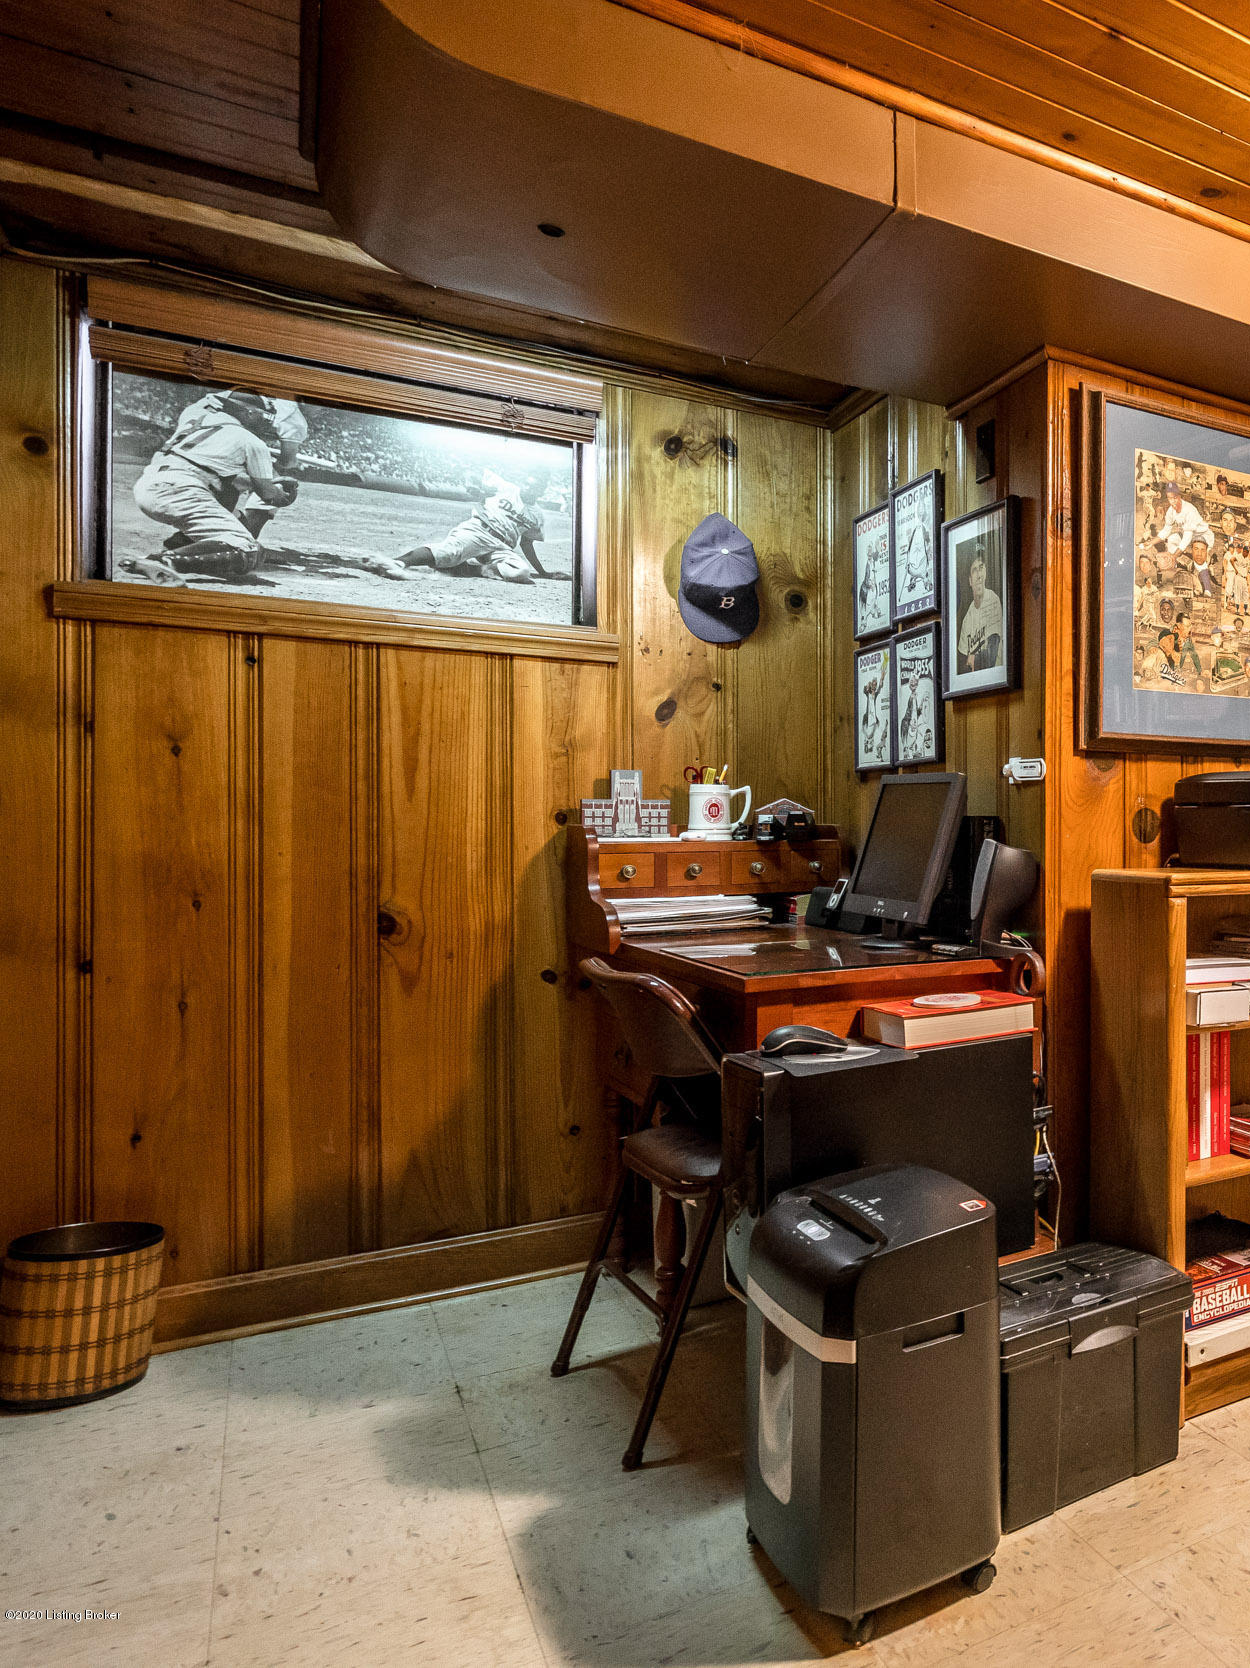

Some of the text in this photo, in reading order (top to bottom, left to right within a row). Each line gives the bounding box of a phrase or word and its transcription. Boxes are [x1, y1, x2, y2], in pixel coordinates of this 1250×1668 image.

[896, 482, 933, 512] DODGERS
[857, 510, 890, 536] DODGERS
[880, 540, 887, 552] IS
[718, 596, 735, 609] B
[904, 602, 931, 615] 1953
[904, 637, 927, 650] DODGER
[860, 653, 881, 668] DODGER
[915, 659, 929, 676] 1955
[1160, 663, 1187, 685] Dodgers
[1215, 1278, 1238, 1292] ESPN
[1193, 1284, 1250, 1314] BASEBALL
[1193, 1298, 1250, 1322] ENCYCLOPEDIA
